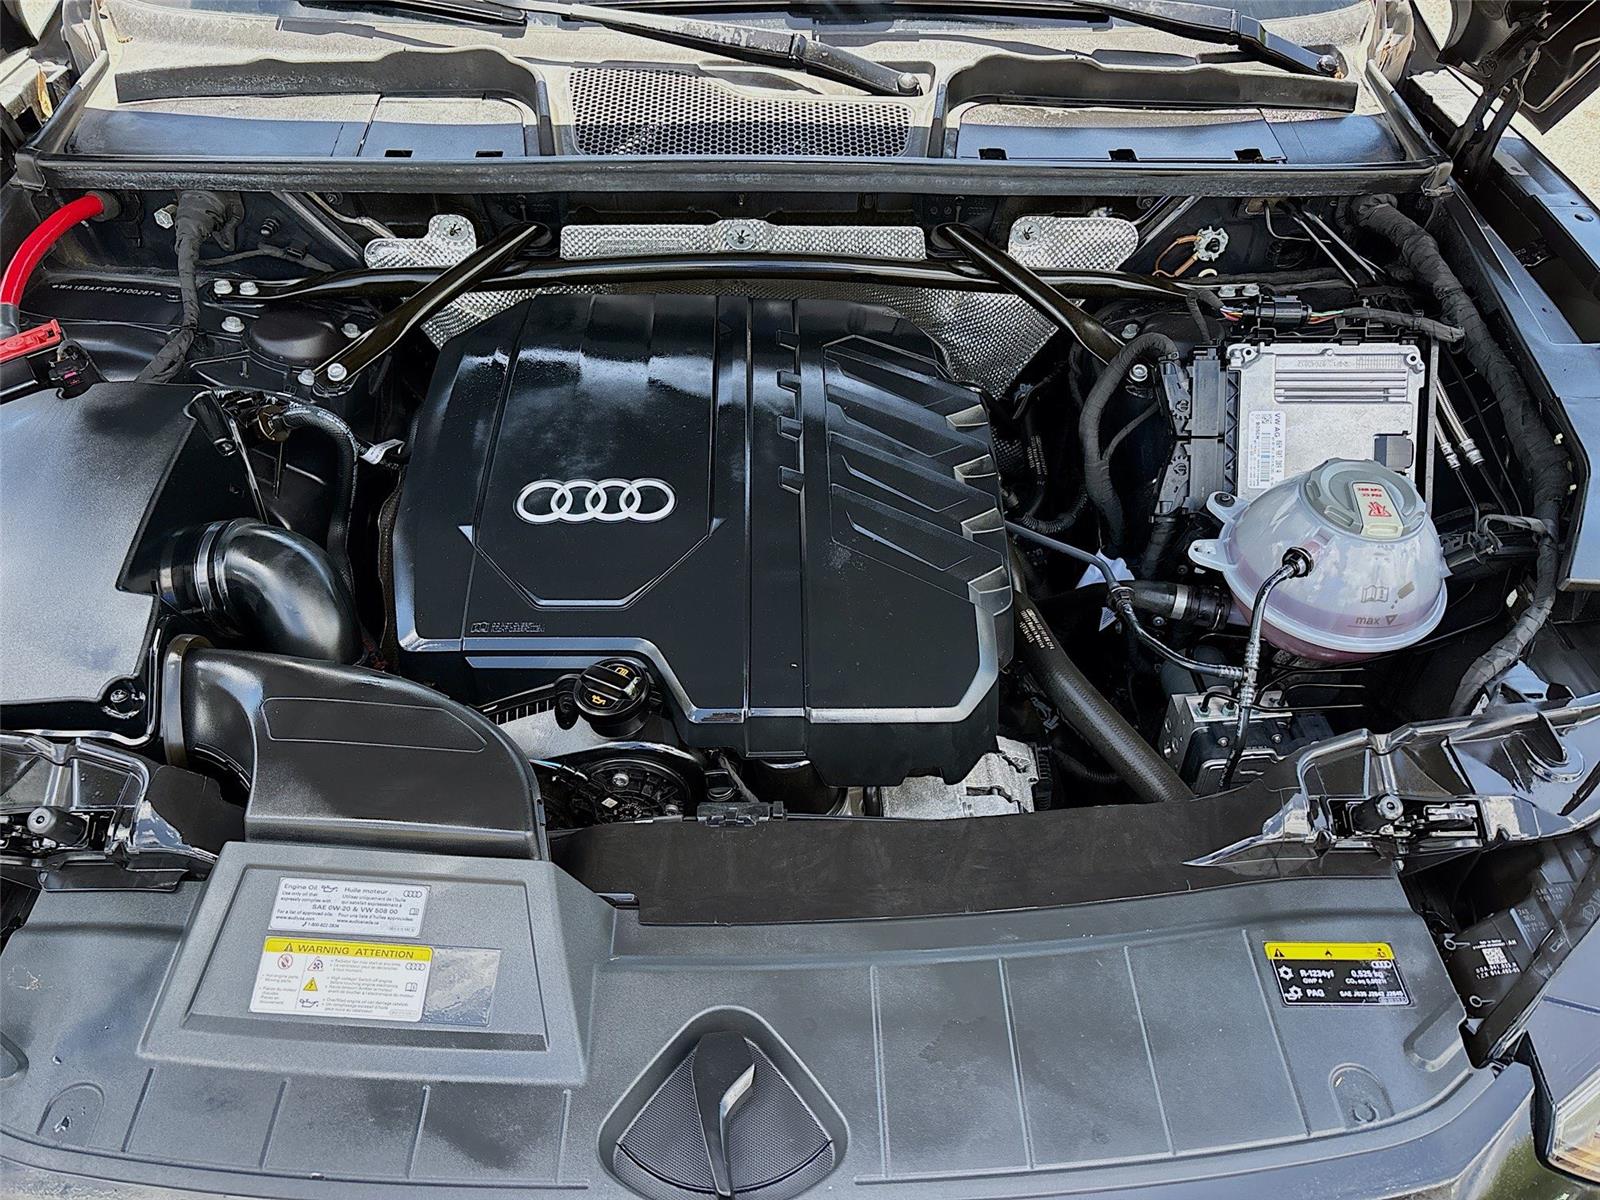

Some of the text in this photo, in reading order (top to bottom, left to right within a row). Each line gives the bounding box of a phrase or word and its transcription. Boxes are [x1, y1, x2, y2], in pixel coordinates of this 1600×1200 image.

[1355, 616, 1381, 625] max
[298, 944, 414, 958] WARNING ATTENTION
